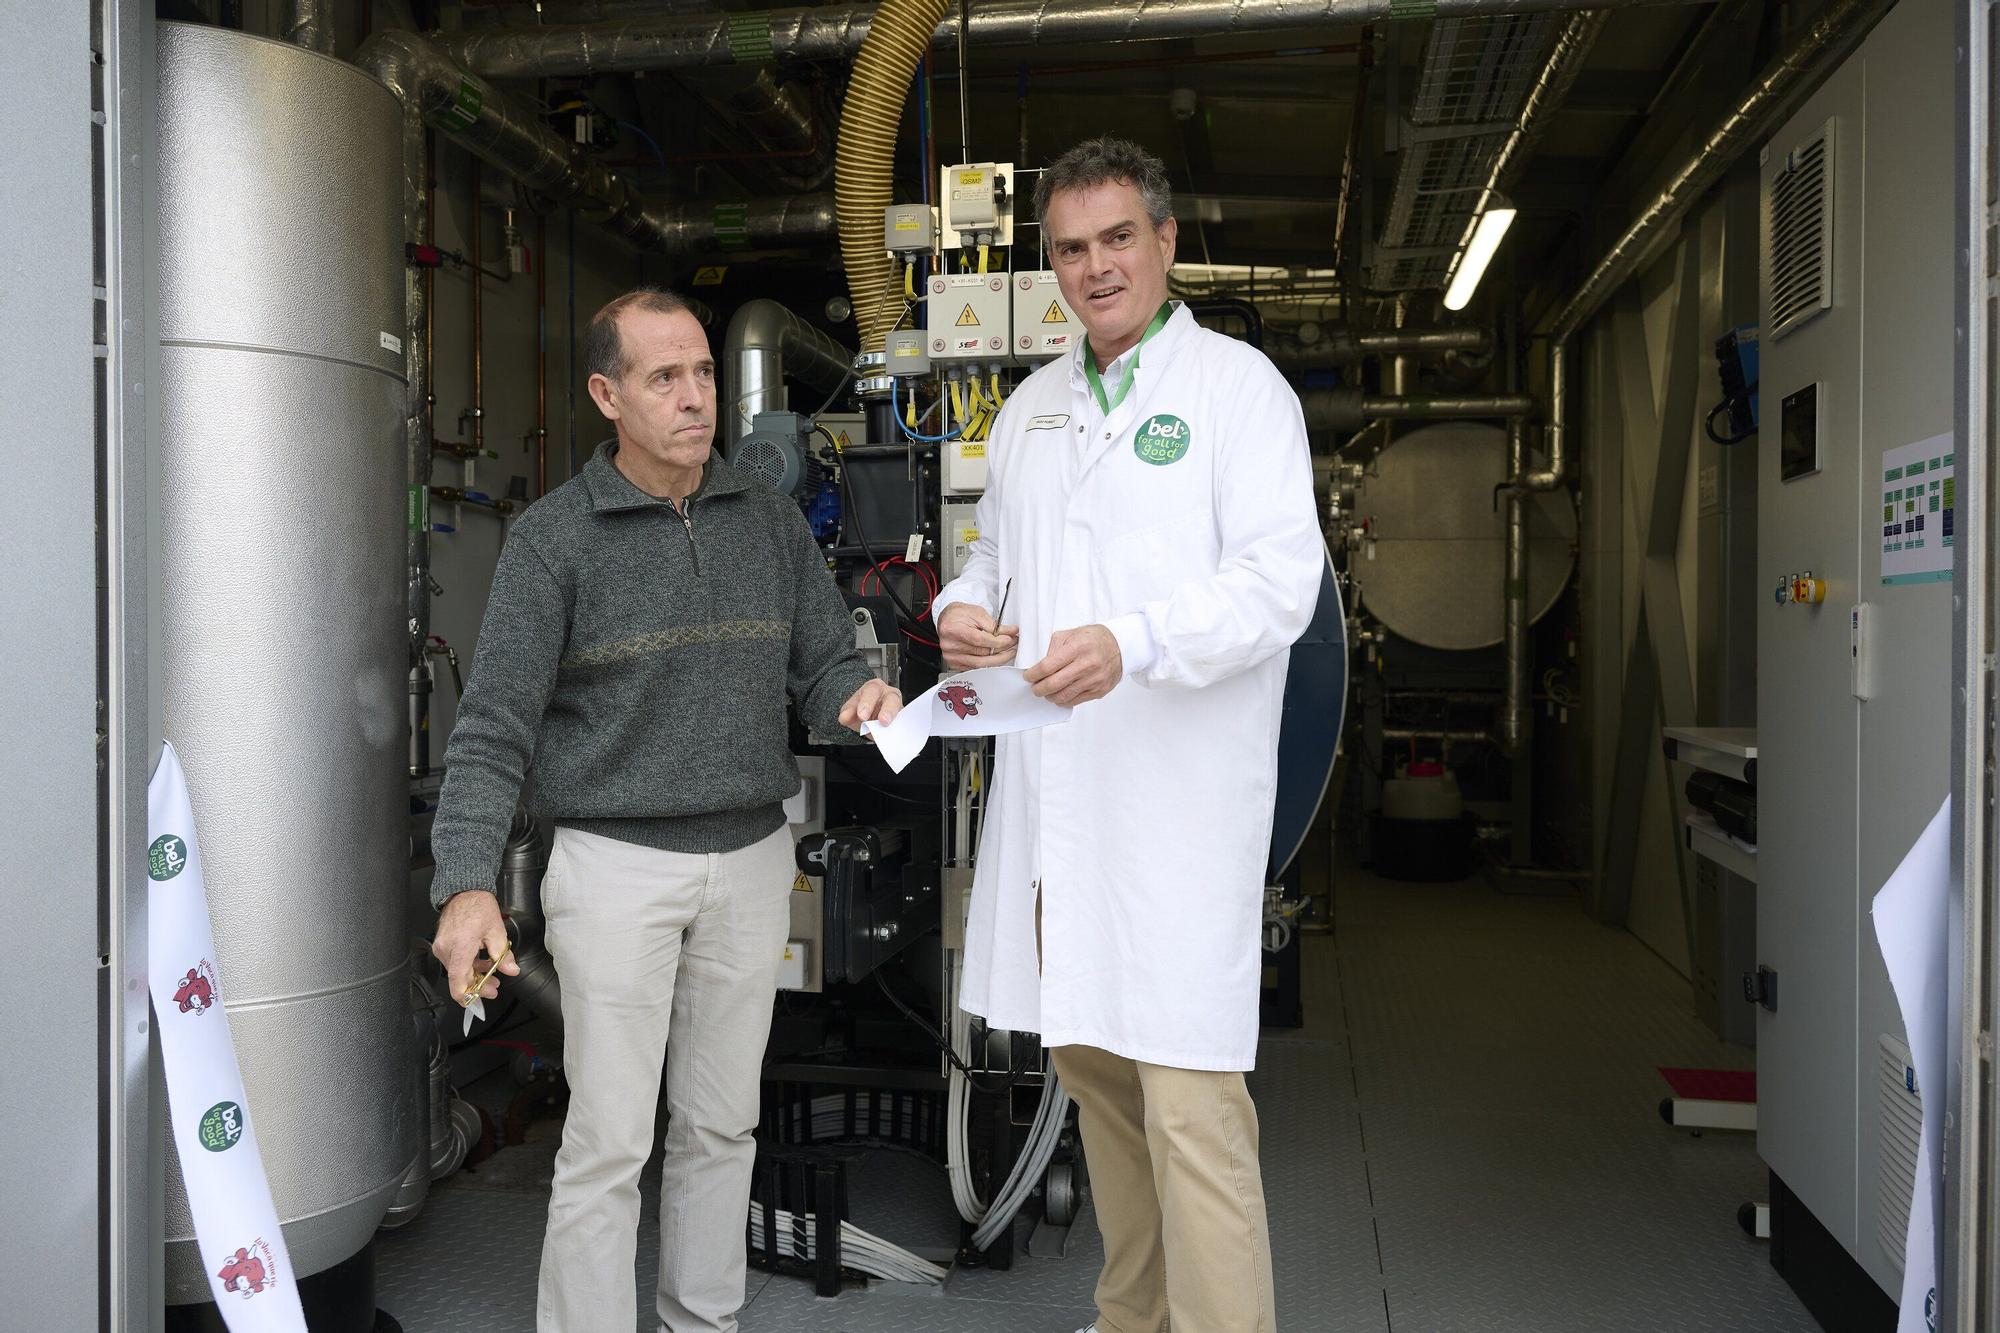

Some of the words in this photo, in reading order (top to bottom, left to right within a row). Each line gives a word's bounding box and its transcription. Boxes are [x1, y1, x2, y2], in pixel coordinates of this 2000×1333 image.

[1147, 417, 1182, 439] bel
[1138, 434, 1154, 444] for
[1154, 438, 1170, 449] all
[1171, 441, 1185, 449] for
[1141, 444, 1178, 459] good
[150, 848, 161, 876] good
[158, 853, 166, 868] all
[163, 838, 184, 871] bel
[213, 1107, 222, 1121] for
[222, 1105, 242, 1140] bel
[203, 1117, 220, 1147] good
[215, 1122, 224, 1138] all
